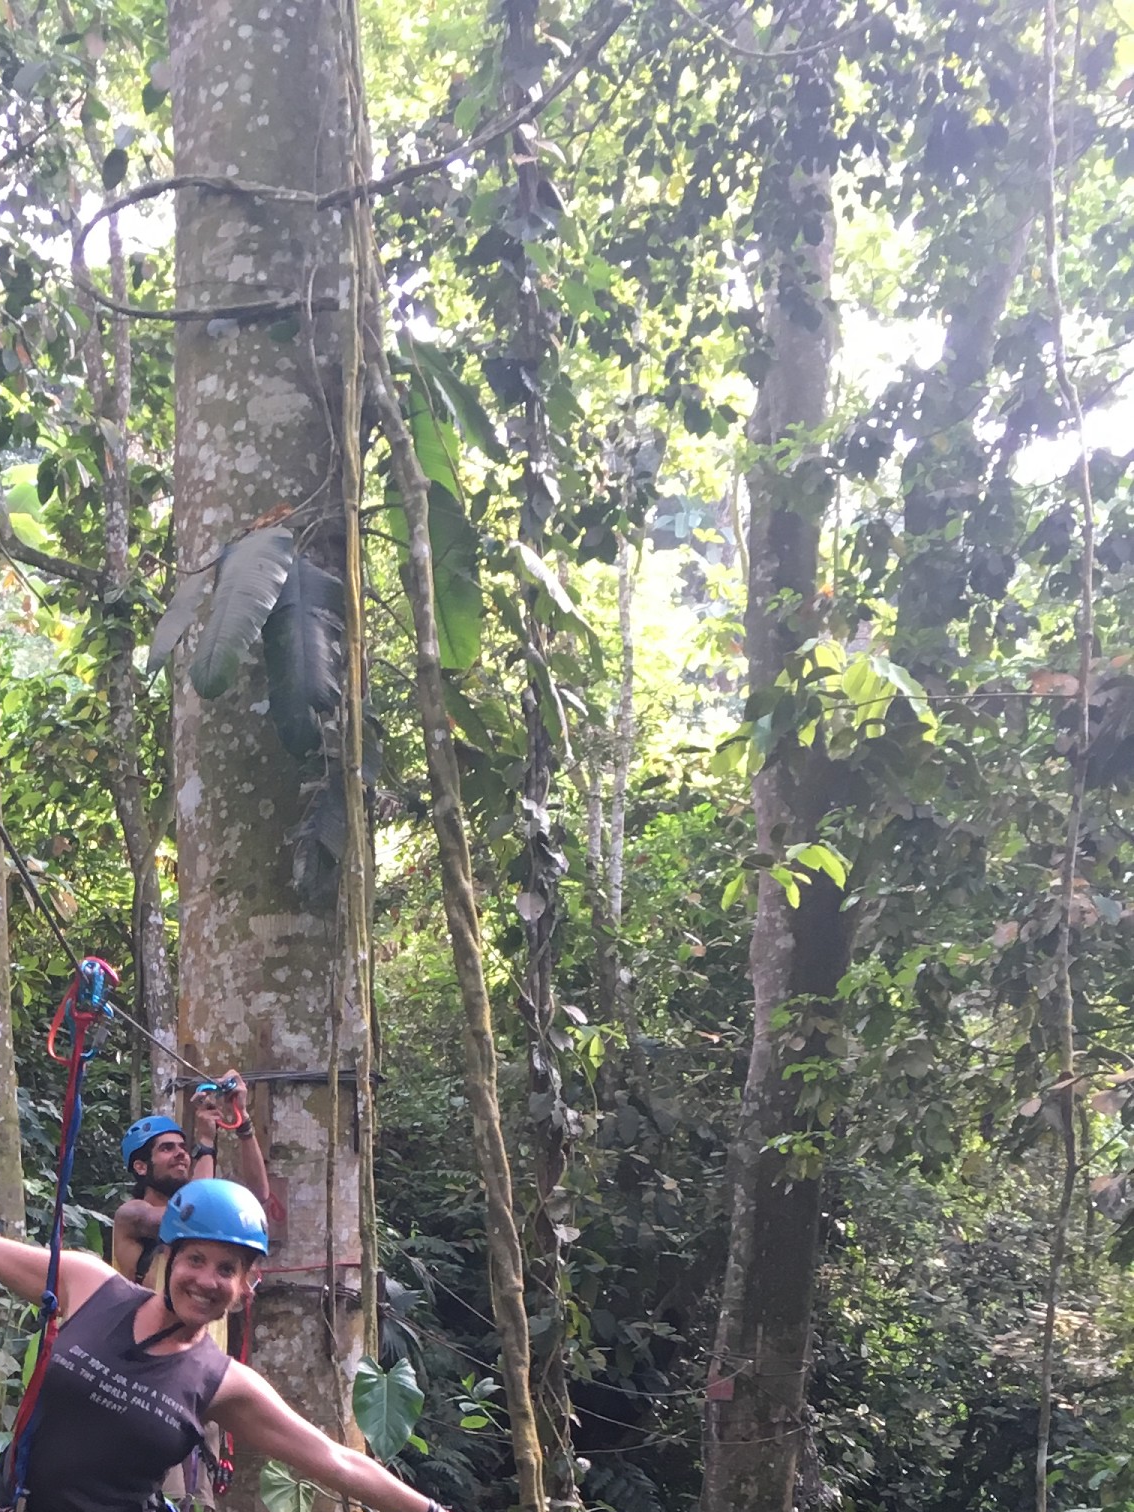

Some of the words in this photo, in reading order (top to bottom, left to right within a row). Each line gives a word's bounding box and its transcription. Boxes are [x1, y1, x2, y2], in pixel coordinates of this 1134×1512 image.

[80, 1368, 96, 1382] THE
[130, 1396, 150, 1411] FALL
[154, 1407, 163, 1417] IN
[132, 1382, 149, 1393] BUY
[151, 1390, 157, 1398] A
